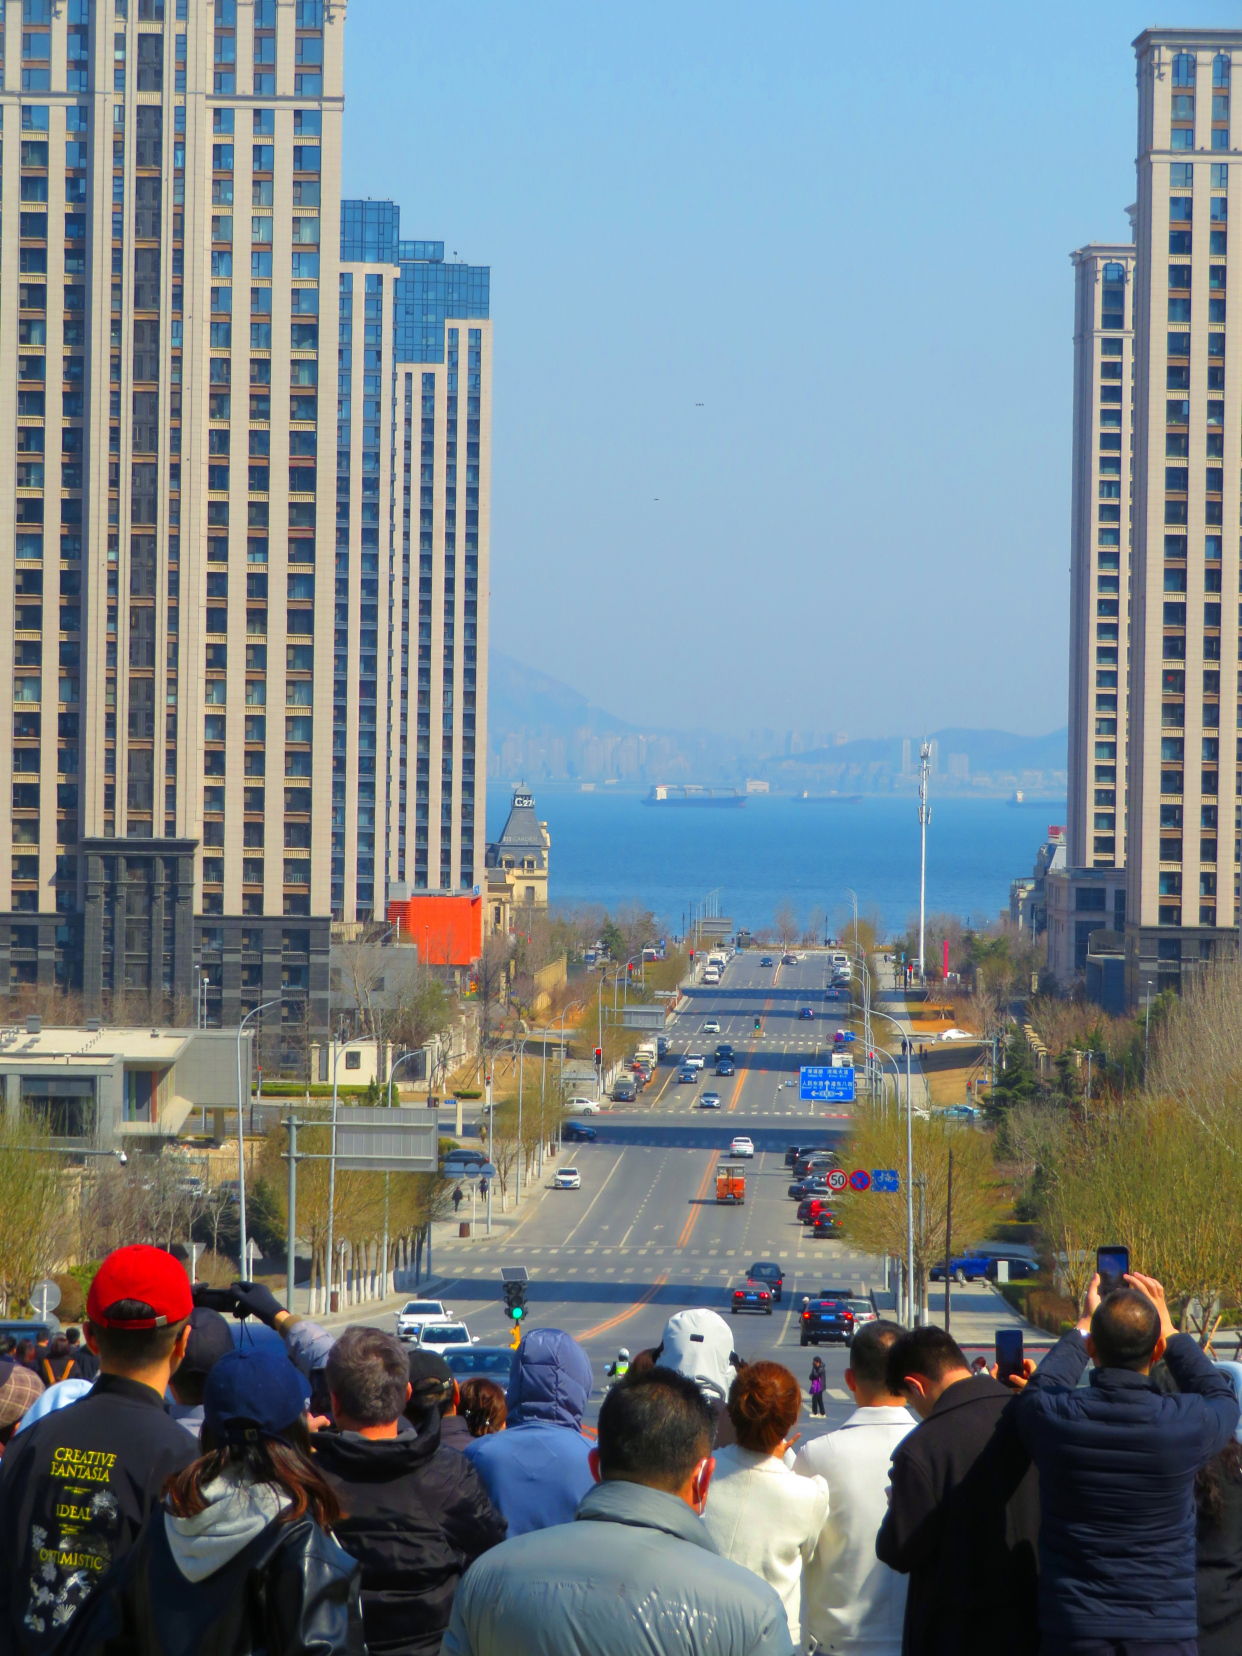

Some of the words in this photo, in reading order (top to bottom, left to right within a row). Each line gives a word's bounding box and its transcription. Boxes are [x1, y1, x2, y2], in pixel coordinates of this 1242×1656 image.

[831, 1174, 845, 1186] 50
[54, 1447, 117, 1467] CREATIVE
[50, 1461, 110, 1482] FANTASIA
[56, 1504, 92, 1520] IDEAL
